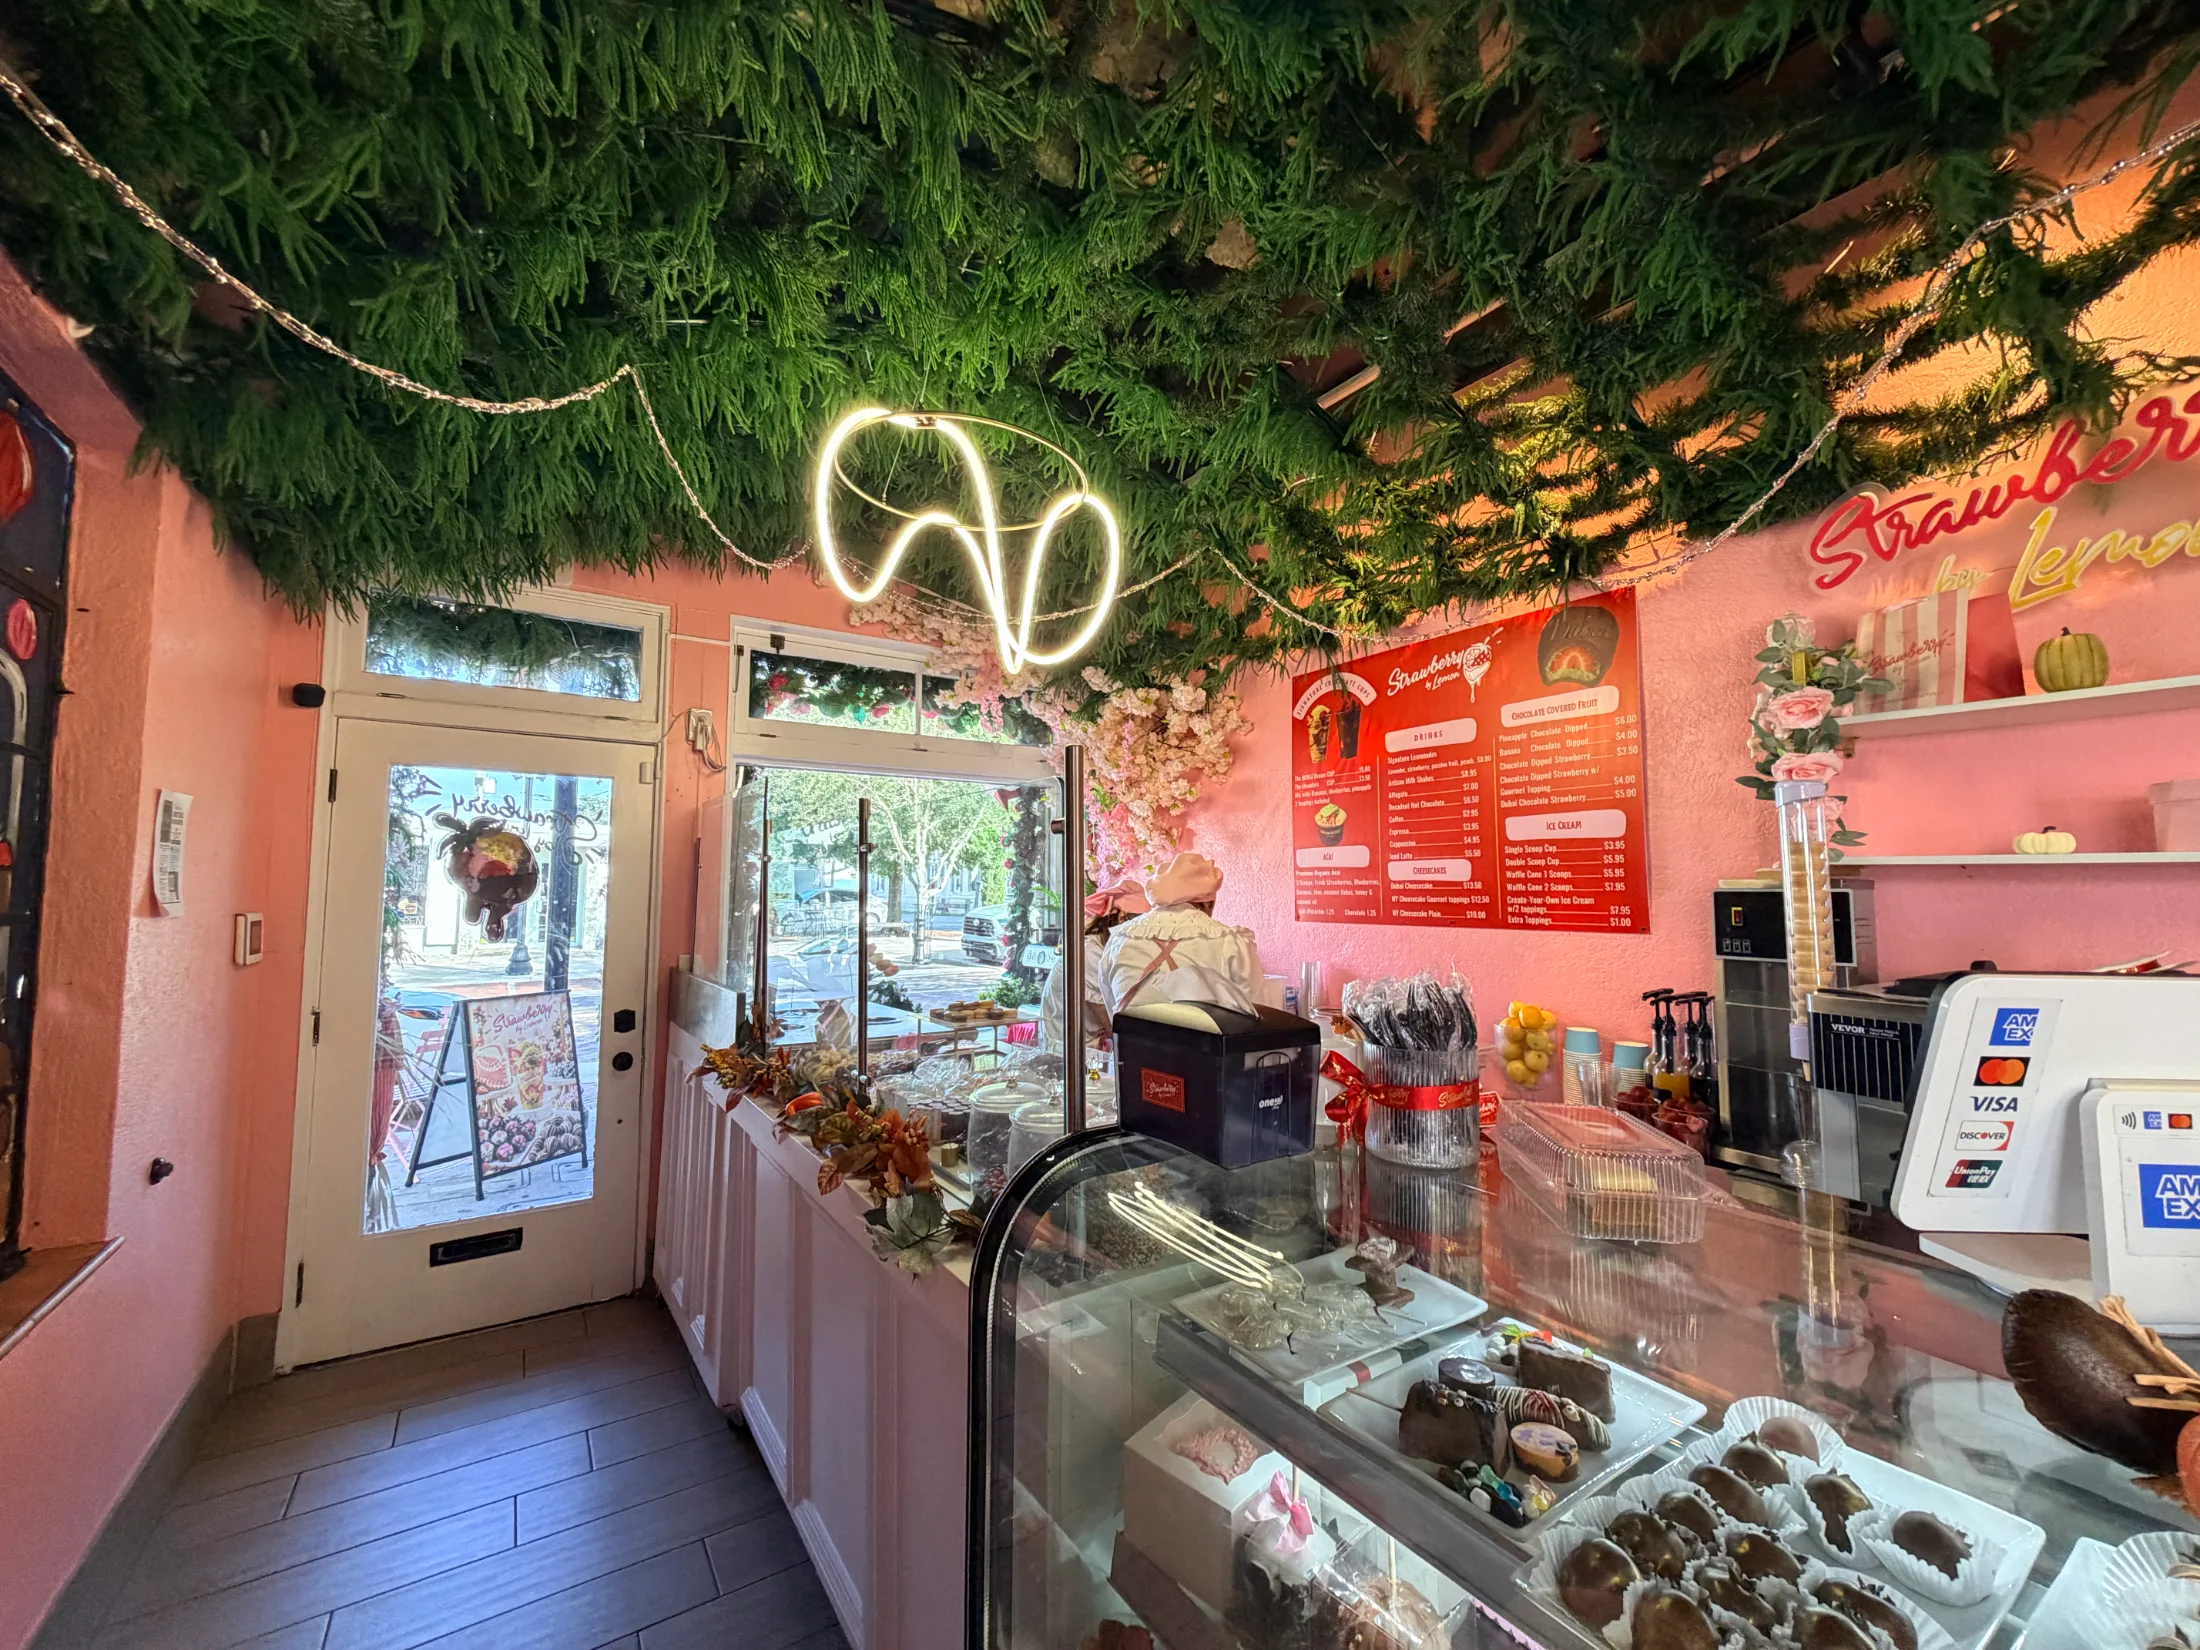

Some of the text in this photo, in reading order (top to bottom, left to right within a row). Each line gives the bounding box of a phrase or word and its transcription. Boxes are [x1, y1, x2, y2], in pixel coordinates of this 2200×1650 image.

[2008, 506, 2200, 611] Lemo
[1387, 650, 1465, 696] Strawberry
[1425, 672, 1460, 691] by Lemon
[1296, 684, 1322, 715] SIGNATURE
[1357, 684, 1371, 698] CUPS
[1511, 699, 1598, 720] CHOCOLATE COVERED FRUIT
[1499, 714, 1637, 743] Pineapple Chocolate Dipped $6.00
[1414, 730, 1443, 742] DRINKS
[1500, 730, 1638, 757] Banana Chocolate Dipped $4.00
[1388, 751, 1437, 765] Signature Lemonades
[1500, 745, 1638, 770] Chocolate Dipped Strawberry $3.50
[1326, 770, 1335, 778] CUP
[1461, 769, 1477, 778] $8.95
[1500, 766, 1600, 784] Chocolate Dipped Strawberry w/
[1463, 782, 1478, 791] $7.00
[1500, 775, 1636, 796] Gourmet Topping $4.00
[1388, 796, 1479, 811] Decadent Hot Chocolate $6.50
[1500, 788, 1636, 808] Dubai Chocolate Strawberry $5.00
[1388, 816, 1404, 824] Coffee
[1546, 821, 1582, 831] ICE CREAM
[1389, 822, 1479, 836] Espresso $3.95
[1504, 840, 1625, 855] Single Scoop Cup $3.95
[1400, 852, 1413, 860] Latte
[1465, 849, 1481, 857] $5.50
[1505, 854, 1625, 867] Double Scoop Cup $5.95
[1413, 866, 1447, 875] CHEESECAKES
[1506, 870, 1526, 879] Waffle
[1527, 870, 1542, 879] Cone
[1549, 870, 1572, 880] Scoops
[1603, 868, 1625, 878] $5.95
[1390, 881, 1482, 890] Dubai Cheesecake $13.50
[1506, 882, 1626, 892] Waffle Cone 2 Scoops $7.95
[1399, 895, 1426, 903] Cheesecake
[1426, 895, 1448, 903] Gourmet
[1471, 895, 1490, 904] $12.50
[1507, 896, 1594, 905] Create-Your-Own Ice Cream
[1400, 909, 1427, 917] Cheesecake
[1428, 909, 1441, 917] Plain
[1466, 911, 1486, 919] $10.00
[1507, 905, 1631, 915] w/2 toppings $7.95
[1508, 915, 1631, 927] Extra Toppings $1.00
[493, 1004, 552, 1033] Strawberry
[524, 1019, 543, 1030] Lemon
[1831, 1023, 1865, 1034] VEVOR
[1970, 1096, 2018, 1112] VISA
[1960, 1132, 2006, 1140] DISCOVER
[1954, 1166, 1996, 1178] UnionPay
